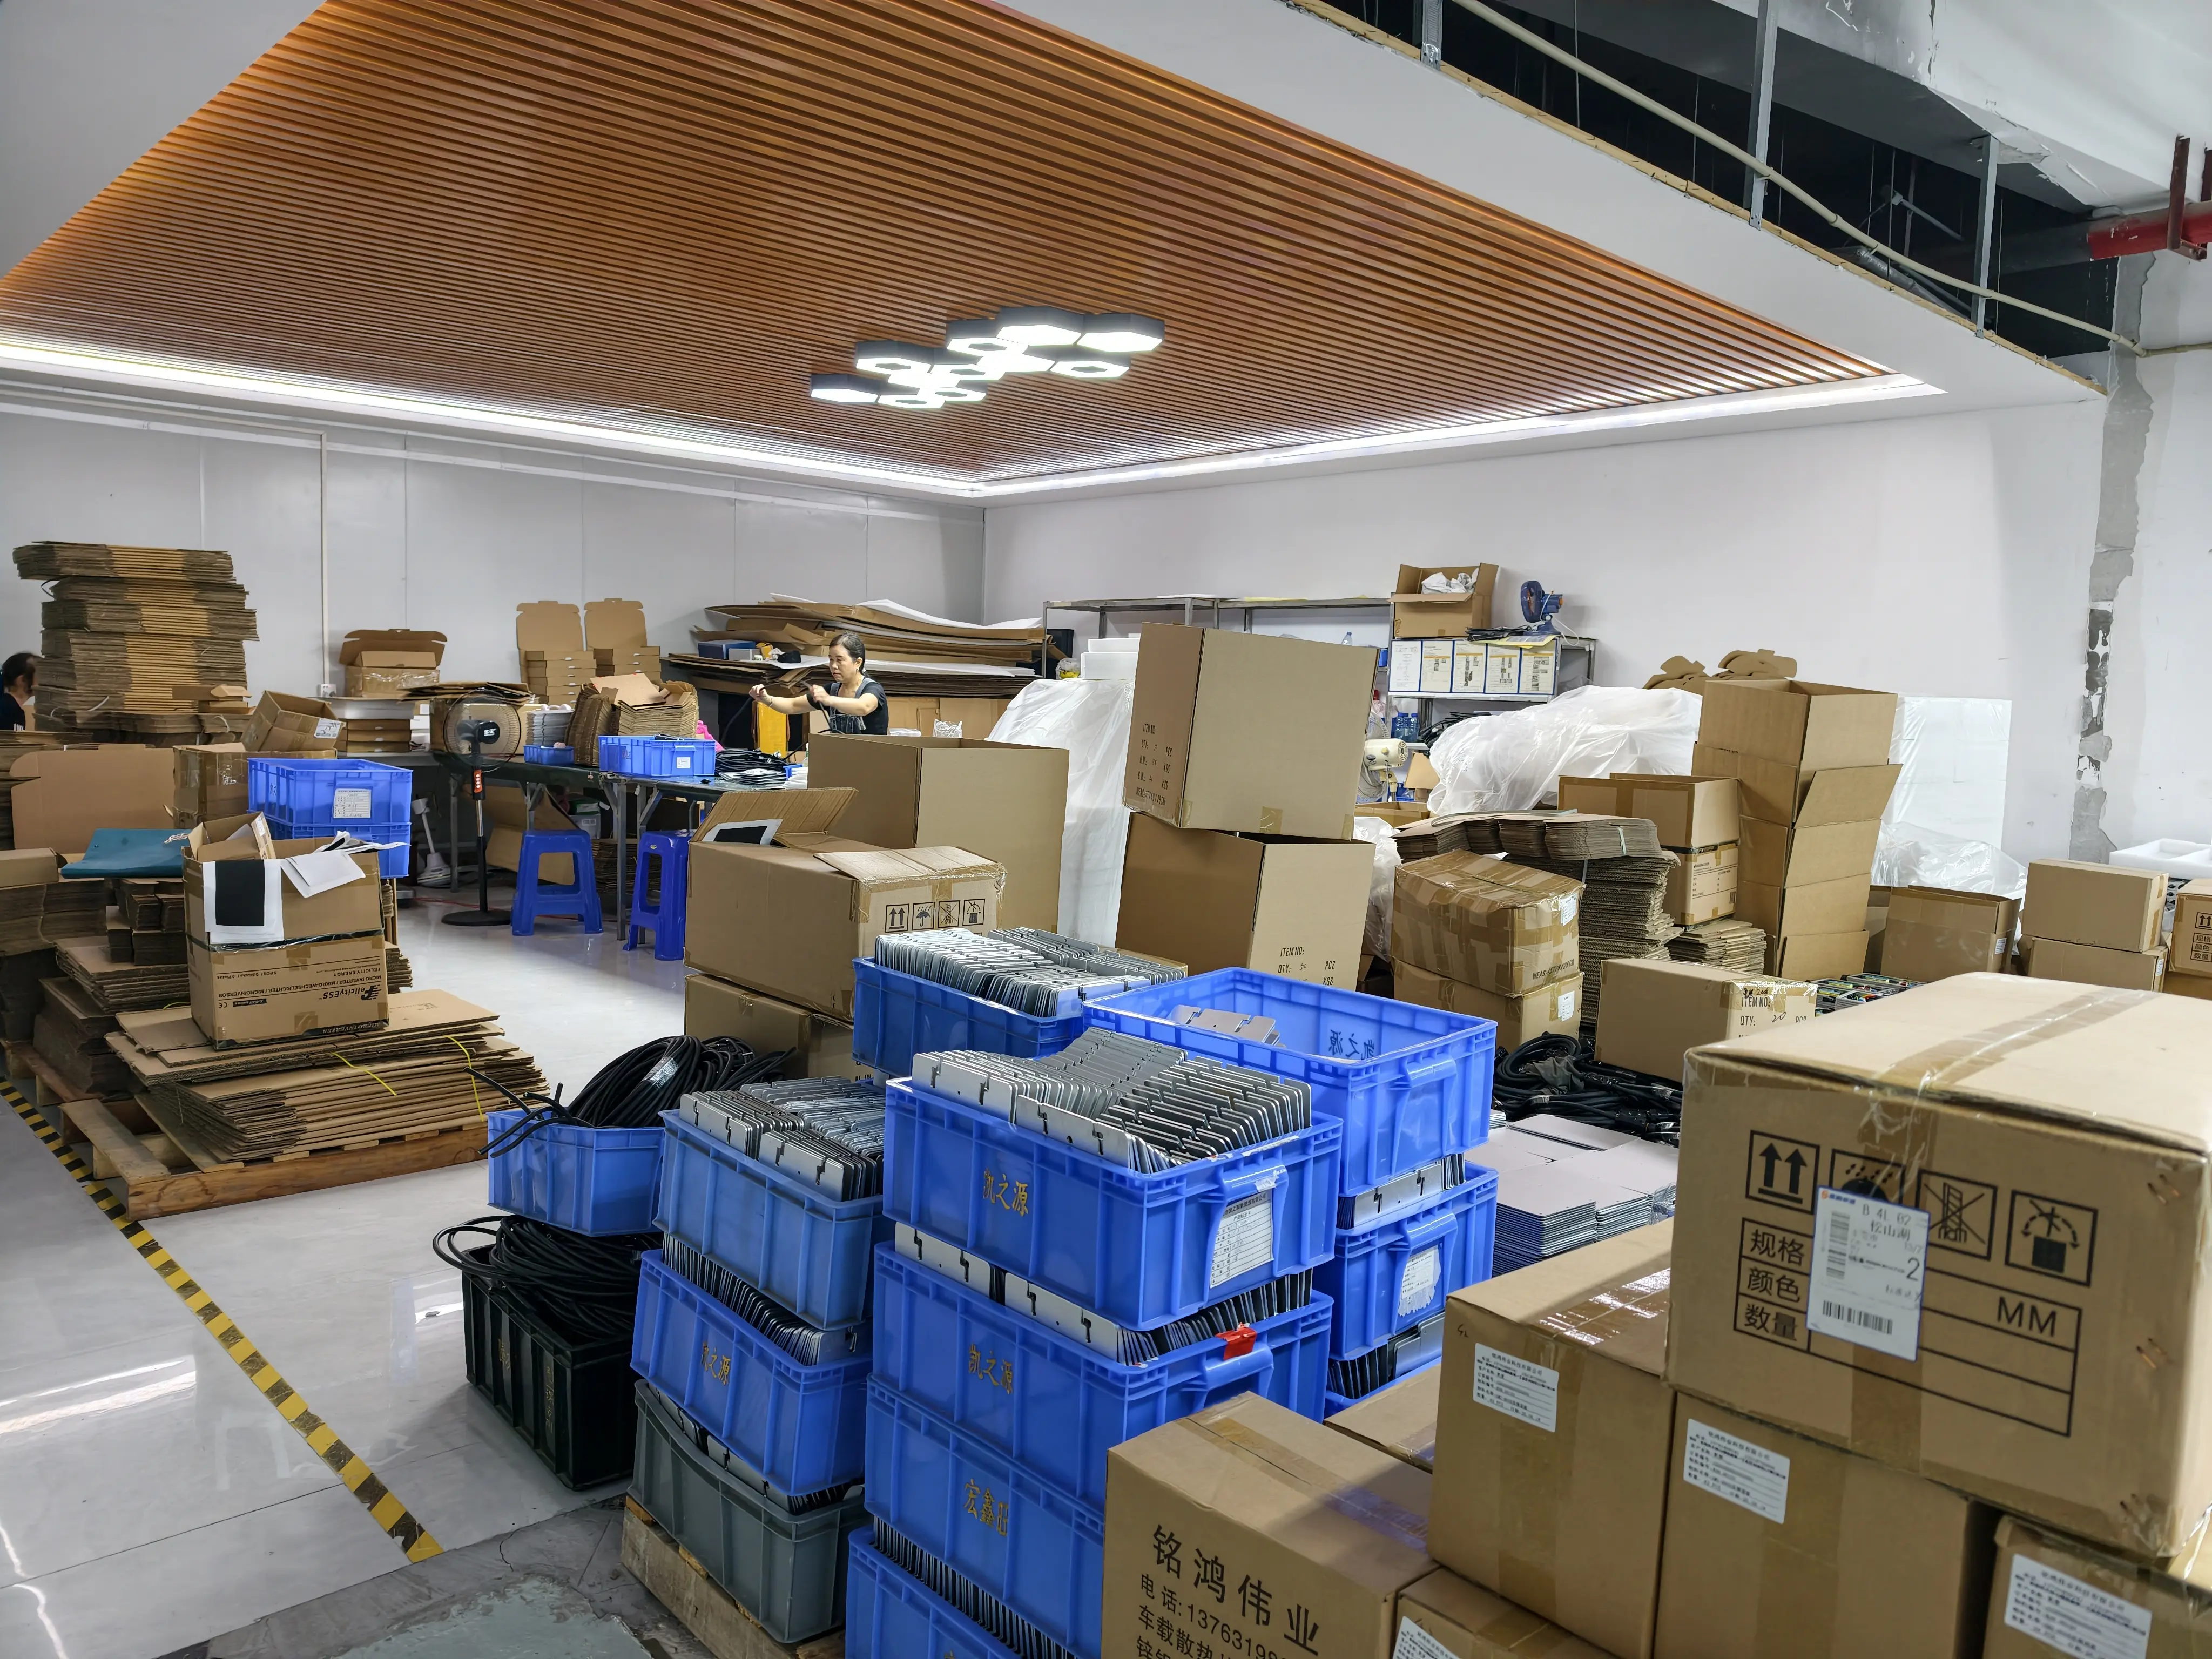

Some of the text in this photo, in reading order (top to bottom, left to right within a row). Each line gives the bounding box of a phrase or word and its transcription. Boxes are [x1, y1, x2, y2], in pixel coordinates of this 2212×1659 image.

[1280, 946, 1304, 957] ITEM NO:
[1325, 960, 1336, 970] PCS
[1278, 963, 1291, 973] QTY:
[1323, 976, 1334, 986] KGS
[1741, 996, 1770, 1008] ITEM NO:
[1771, 1011, 1786, 1023] 20
[1740, 1015, 1756, 1026] QTY:
[983, 1167, 1029, 1217] 凯之源
[1750, 1229, 1805, 1266] 规格
[1747, 1266, 1800, 1303] 颜色
[1906, 1256, 1920, 1282] 2
[1744, 1303, 1798, 1341] 数量
[1997, 1296, 2056, 1338] MM
[969, 1342, 1014, 1395] 凯之源
[1153, 1524, 1319, 1656] 铭鸿伟业
[1138, 1604, 1231, 1659] 车载散热
